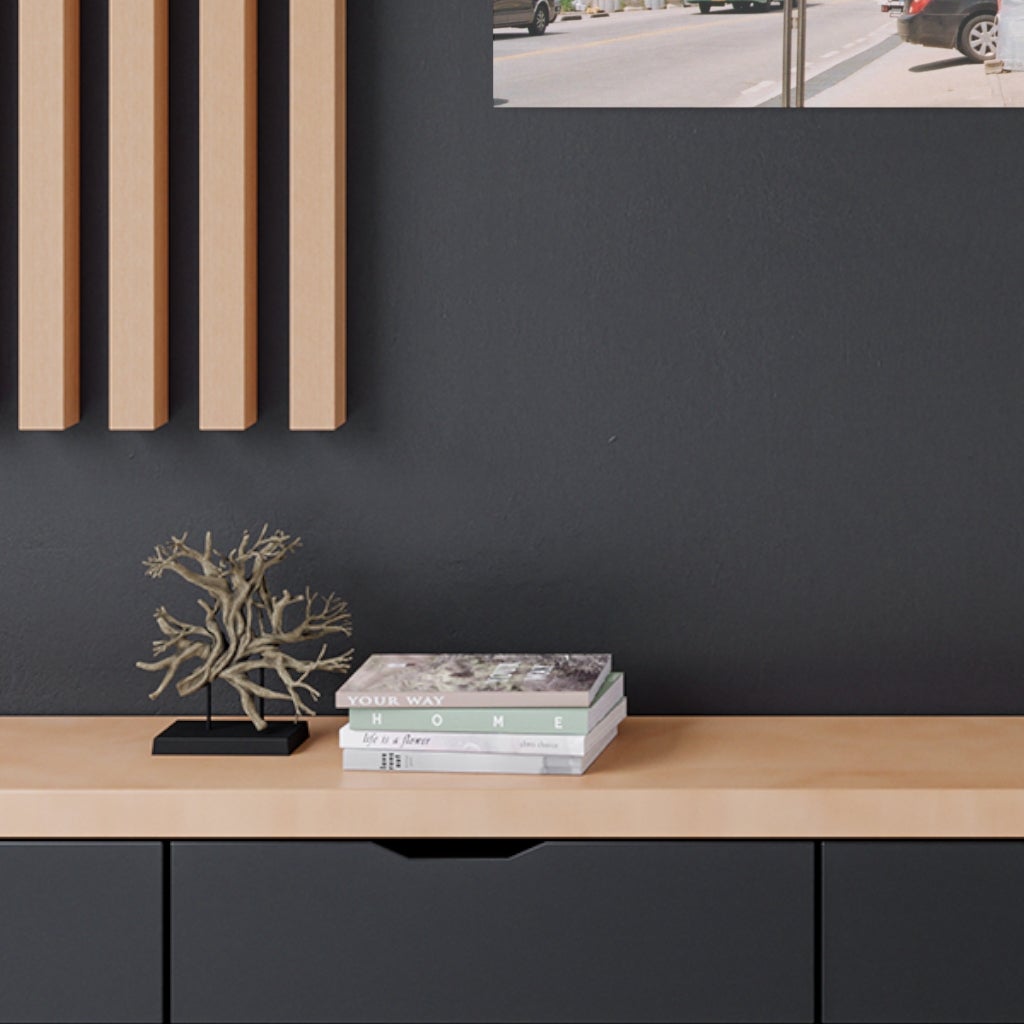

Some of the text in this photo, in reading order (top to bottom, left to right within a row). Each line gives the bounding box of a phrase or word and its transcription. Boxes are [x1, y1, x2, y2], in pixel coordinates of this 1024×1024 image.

[348, 695, 445, 706] YOUR WAY
[363, 732, 378, 746] life
[401, 734, 431, 748] flower
